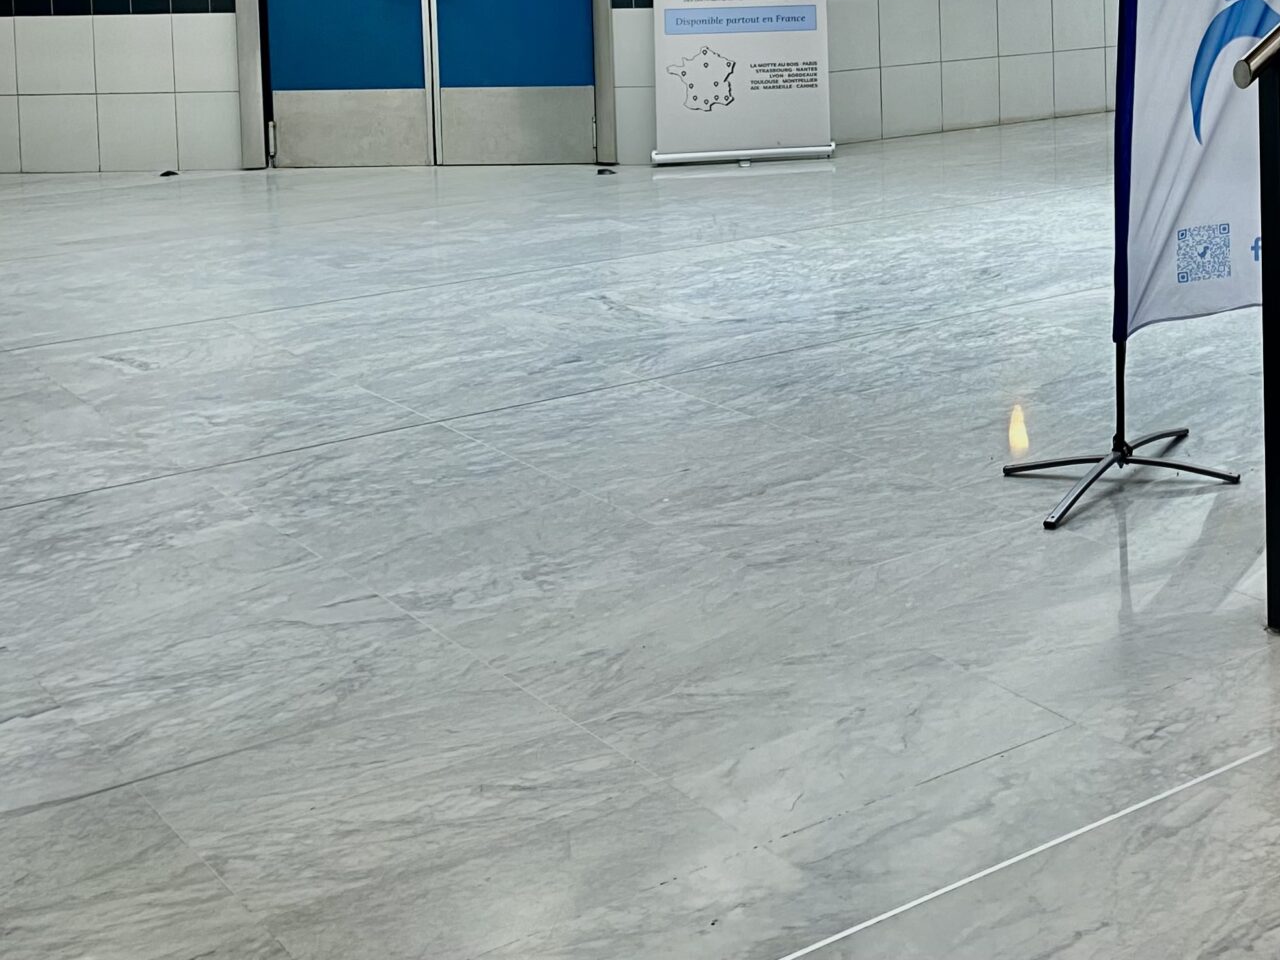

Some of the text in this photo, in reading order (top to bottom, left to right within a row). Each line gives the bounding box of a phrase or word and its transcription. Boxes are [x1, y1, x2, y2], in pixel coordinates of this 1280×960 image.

[675, 12, 806, 28] Disponible partout en France
